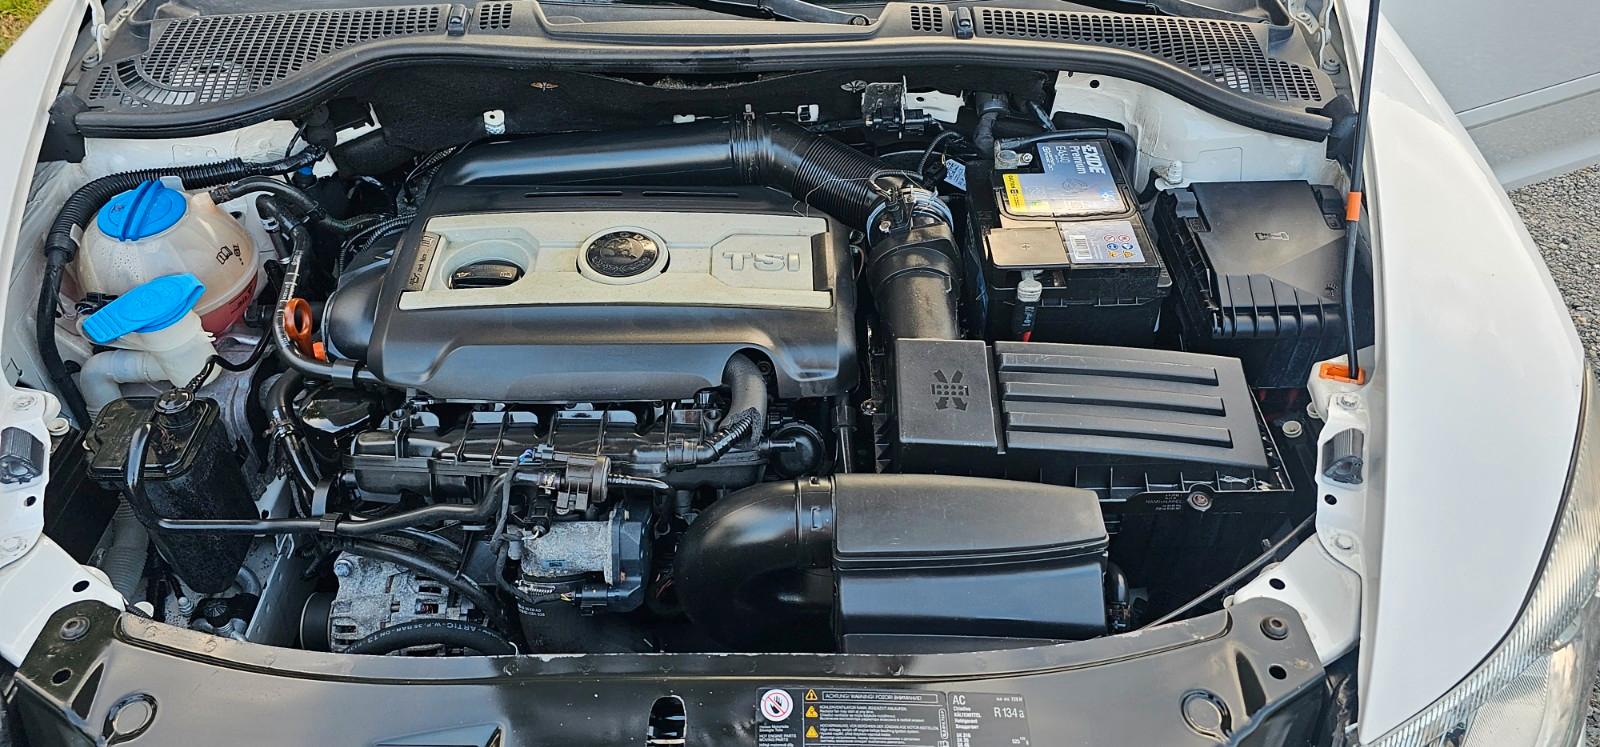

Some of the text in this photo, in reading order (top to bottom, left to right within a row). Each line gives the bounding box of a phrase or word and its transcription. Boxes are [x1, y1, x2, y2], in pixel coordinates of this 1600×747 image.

[1069, 145, 1087, 174] Premium
[1081, 144, 1106, 175] EXIDE
[722, 251, 801, 272] TSI
[446, 622, 477, 632] ARTIC
[953, 694, 966, 705] AC
[993, 706, 1002, 718] R
